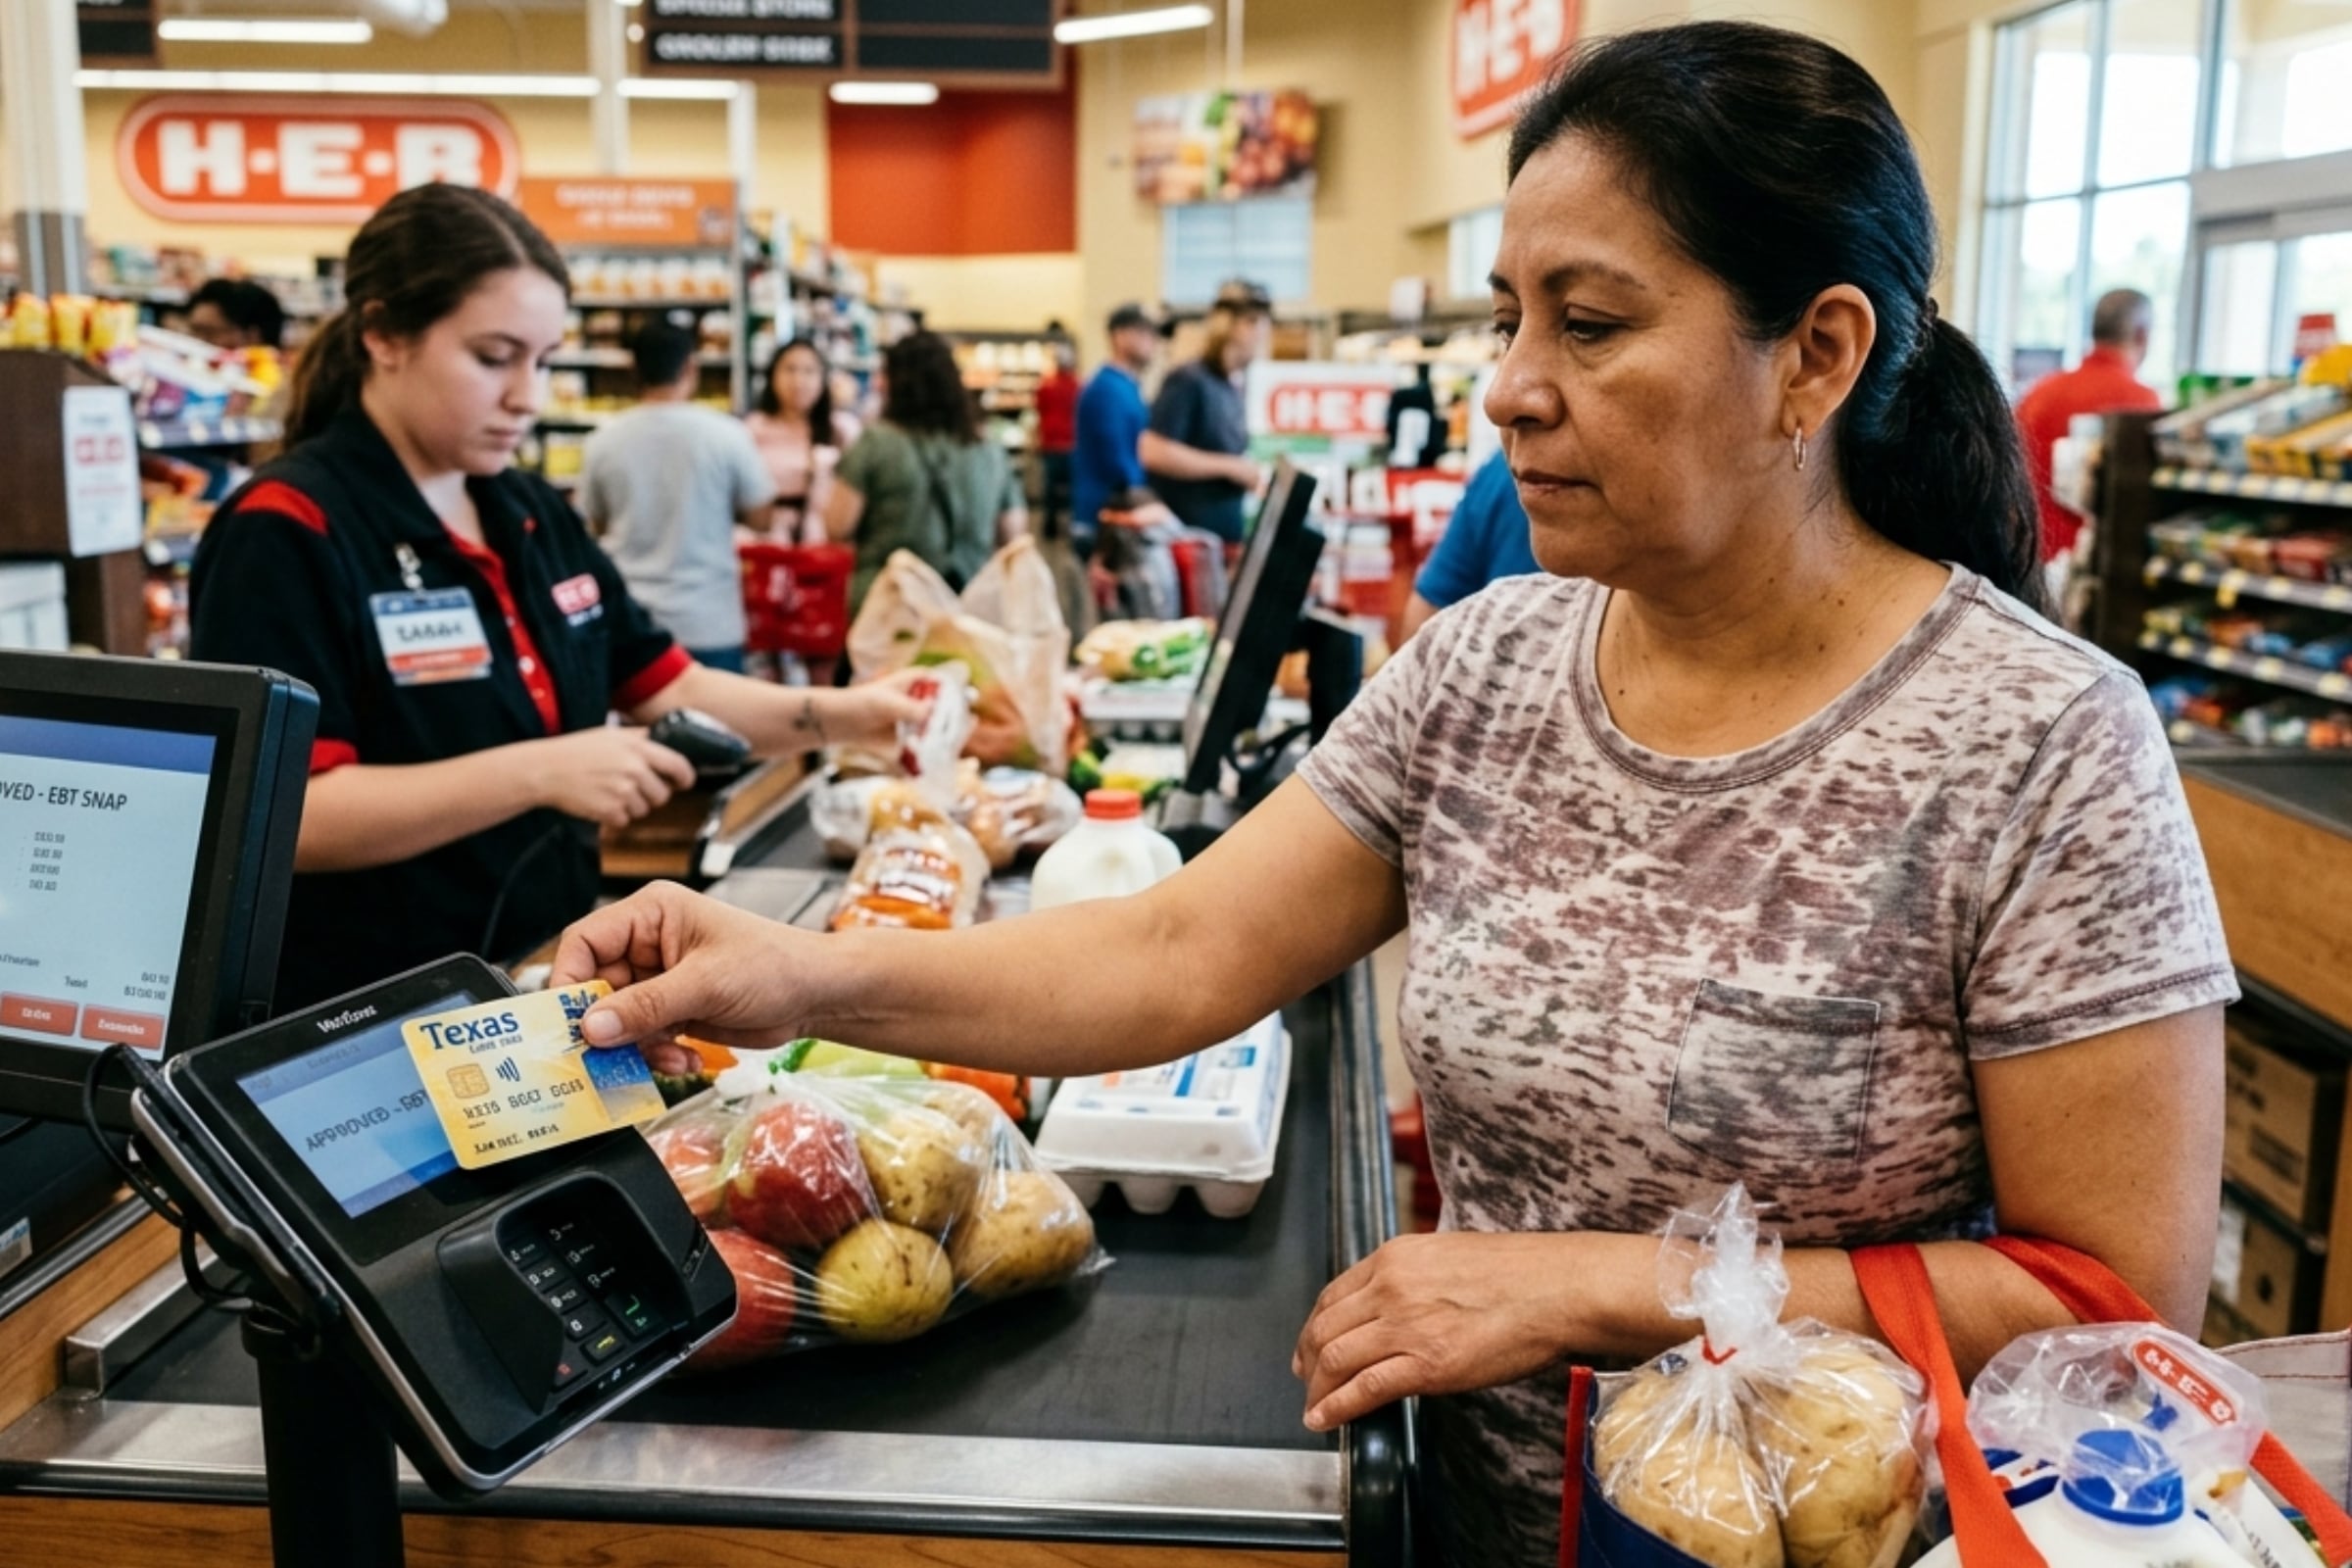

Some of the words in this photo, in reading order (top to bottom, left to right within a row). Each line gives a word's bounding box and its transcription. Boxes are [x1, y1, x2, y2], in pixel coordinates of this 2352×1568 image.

[48, 786, 79, 806] EBT
[81, 790, 128, 811] SNAP
[419, 1012, 519, 1050] Texas
